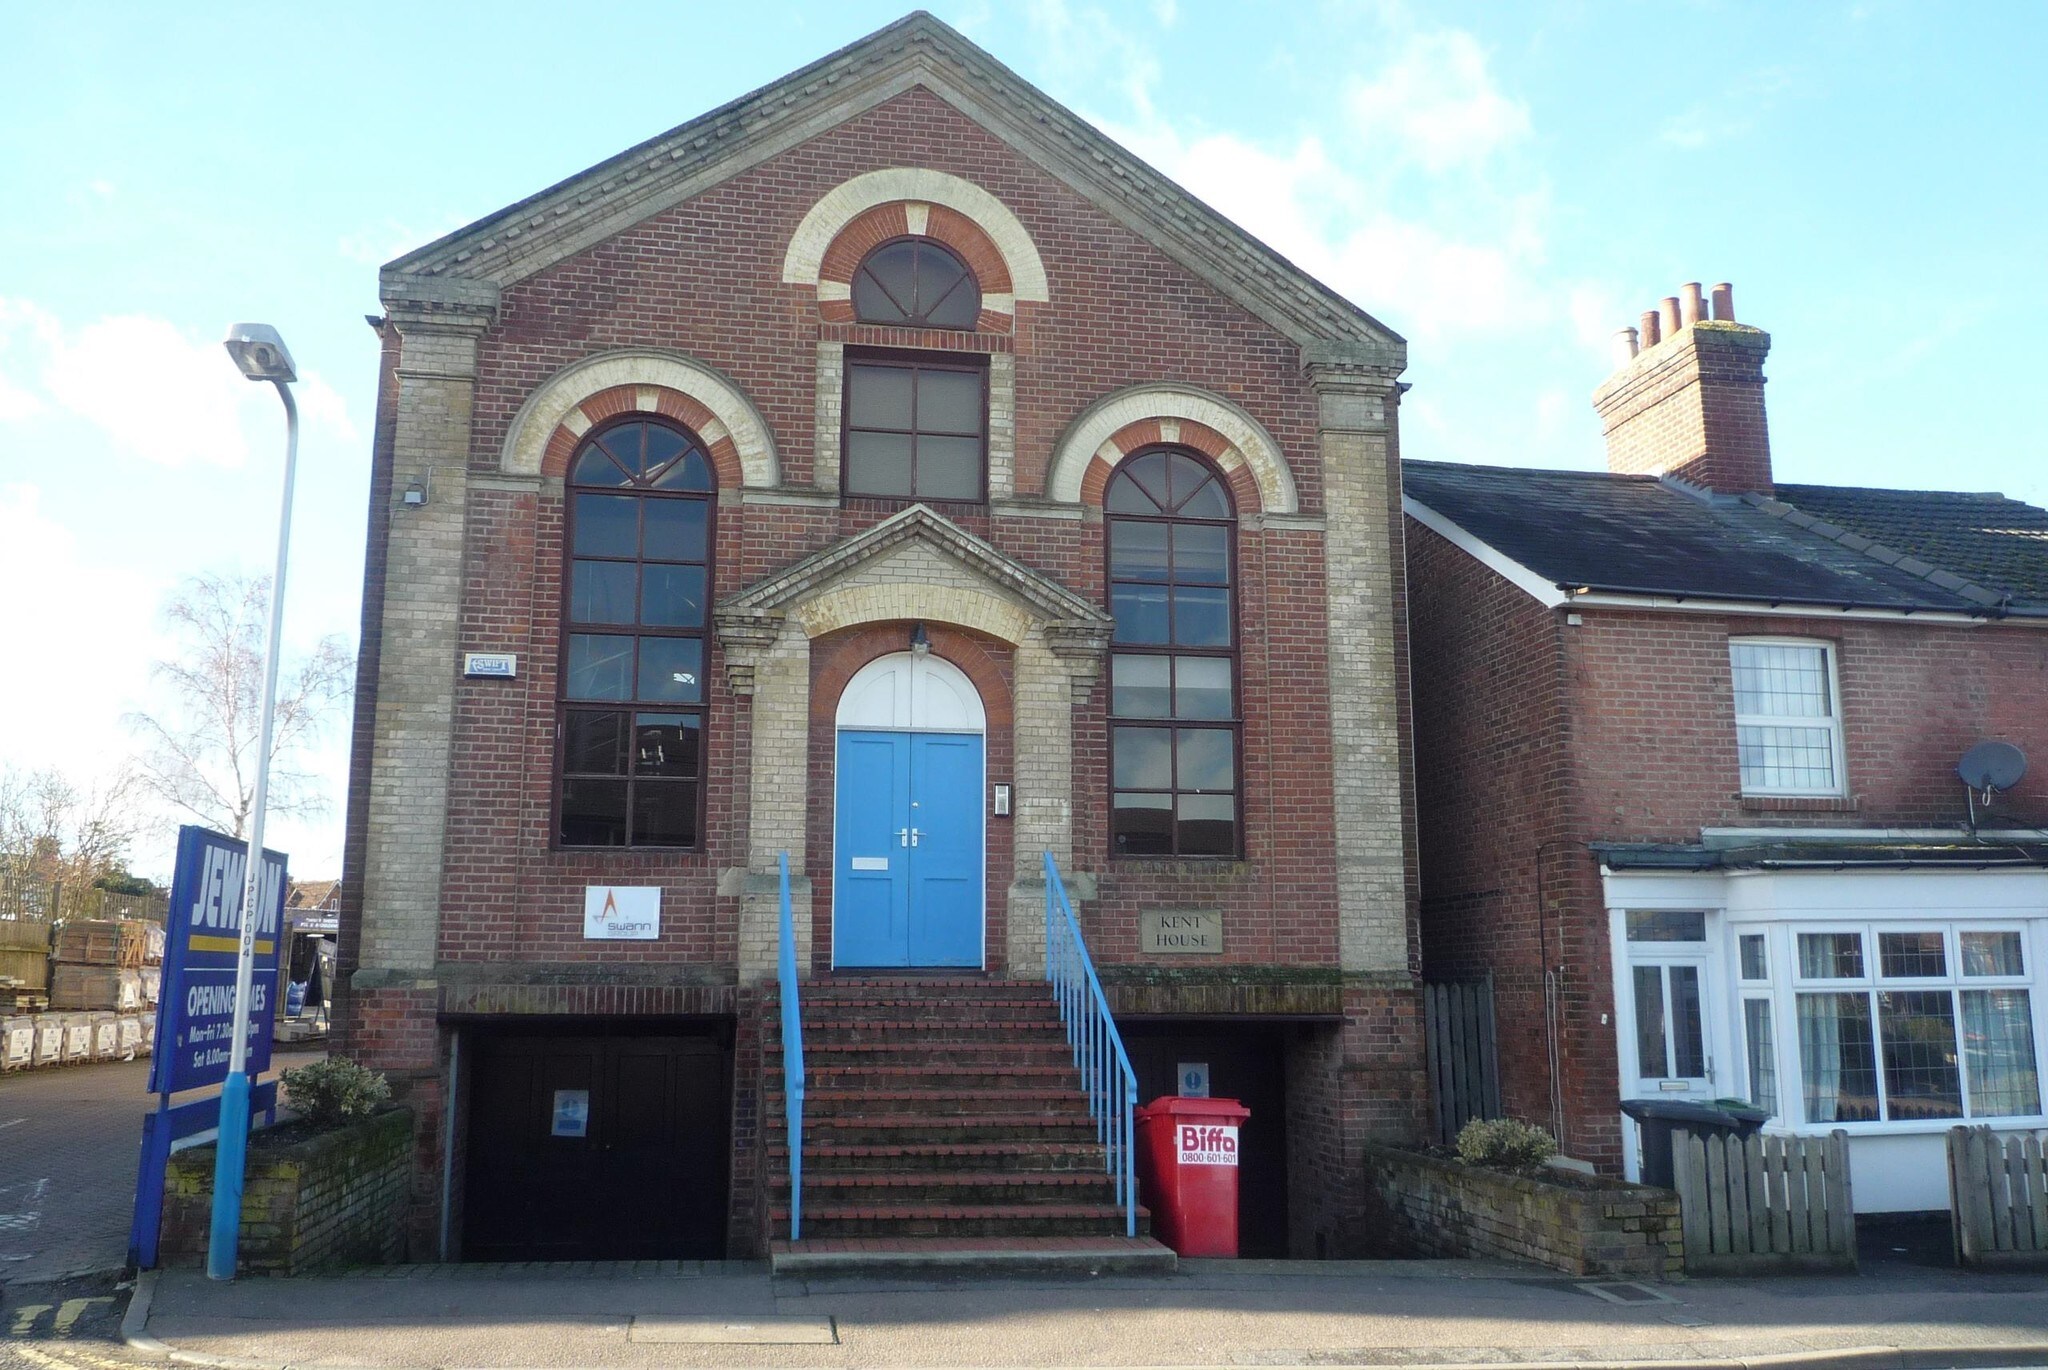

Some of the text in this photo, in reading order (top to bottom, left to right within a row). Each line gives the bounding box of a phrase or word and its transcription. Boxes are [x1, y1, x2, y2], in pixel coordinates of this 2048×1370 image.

[191, 845, 281, 933] JEWON
[1161, 916, 1201, 928] KENT
[1157, 934, 1208, 946] HOUSE
[188, 984, 266, 1017] OPENING MES
[193, 1051, 205, 1068] Sat
[1182, 1127, 1235, 1152] Biffa
